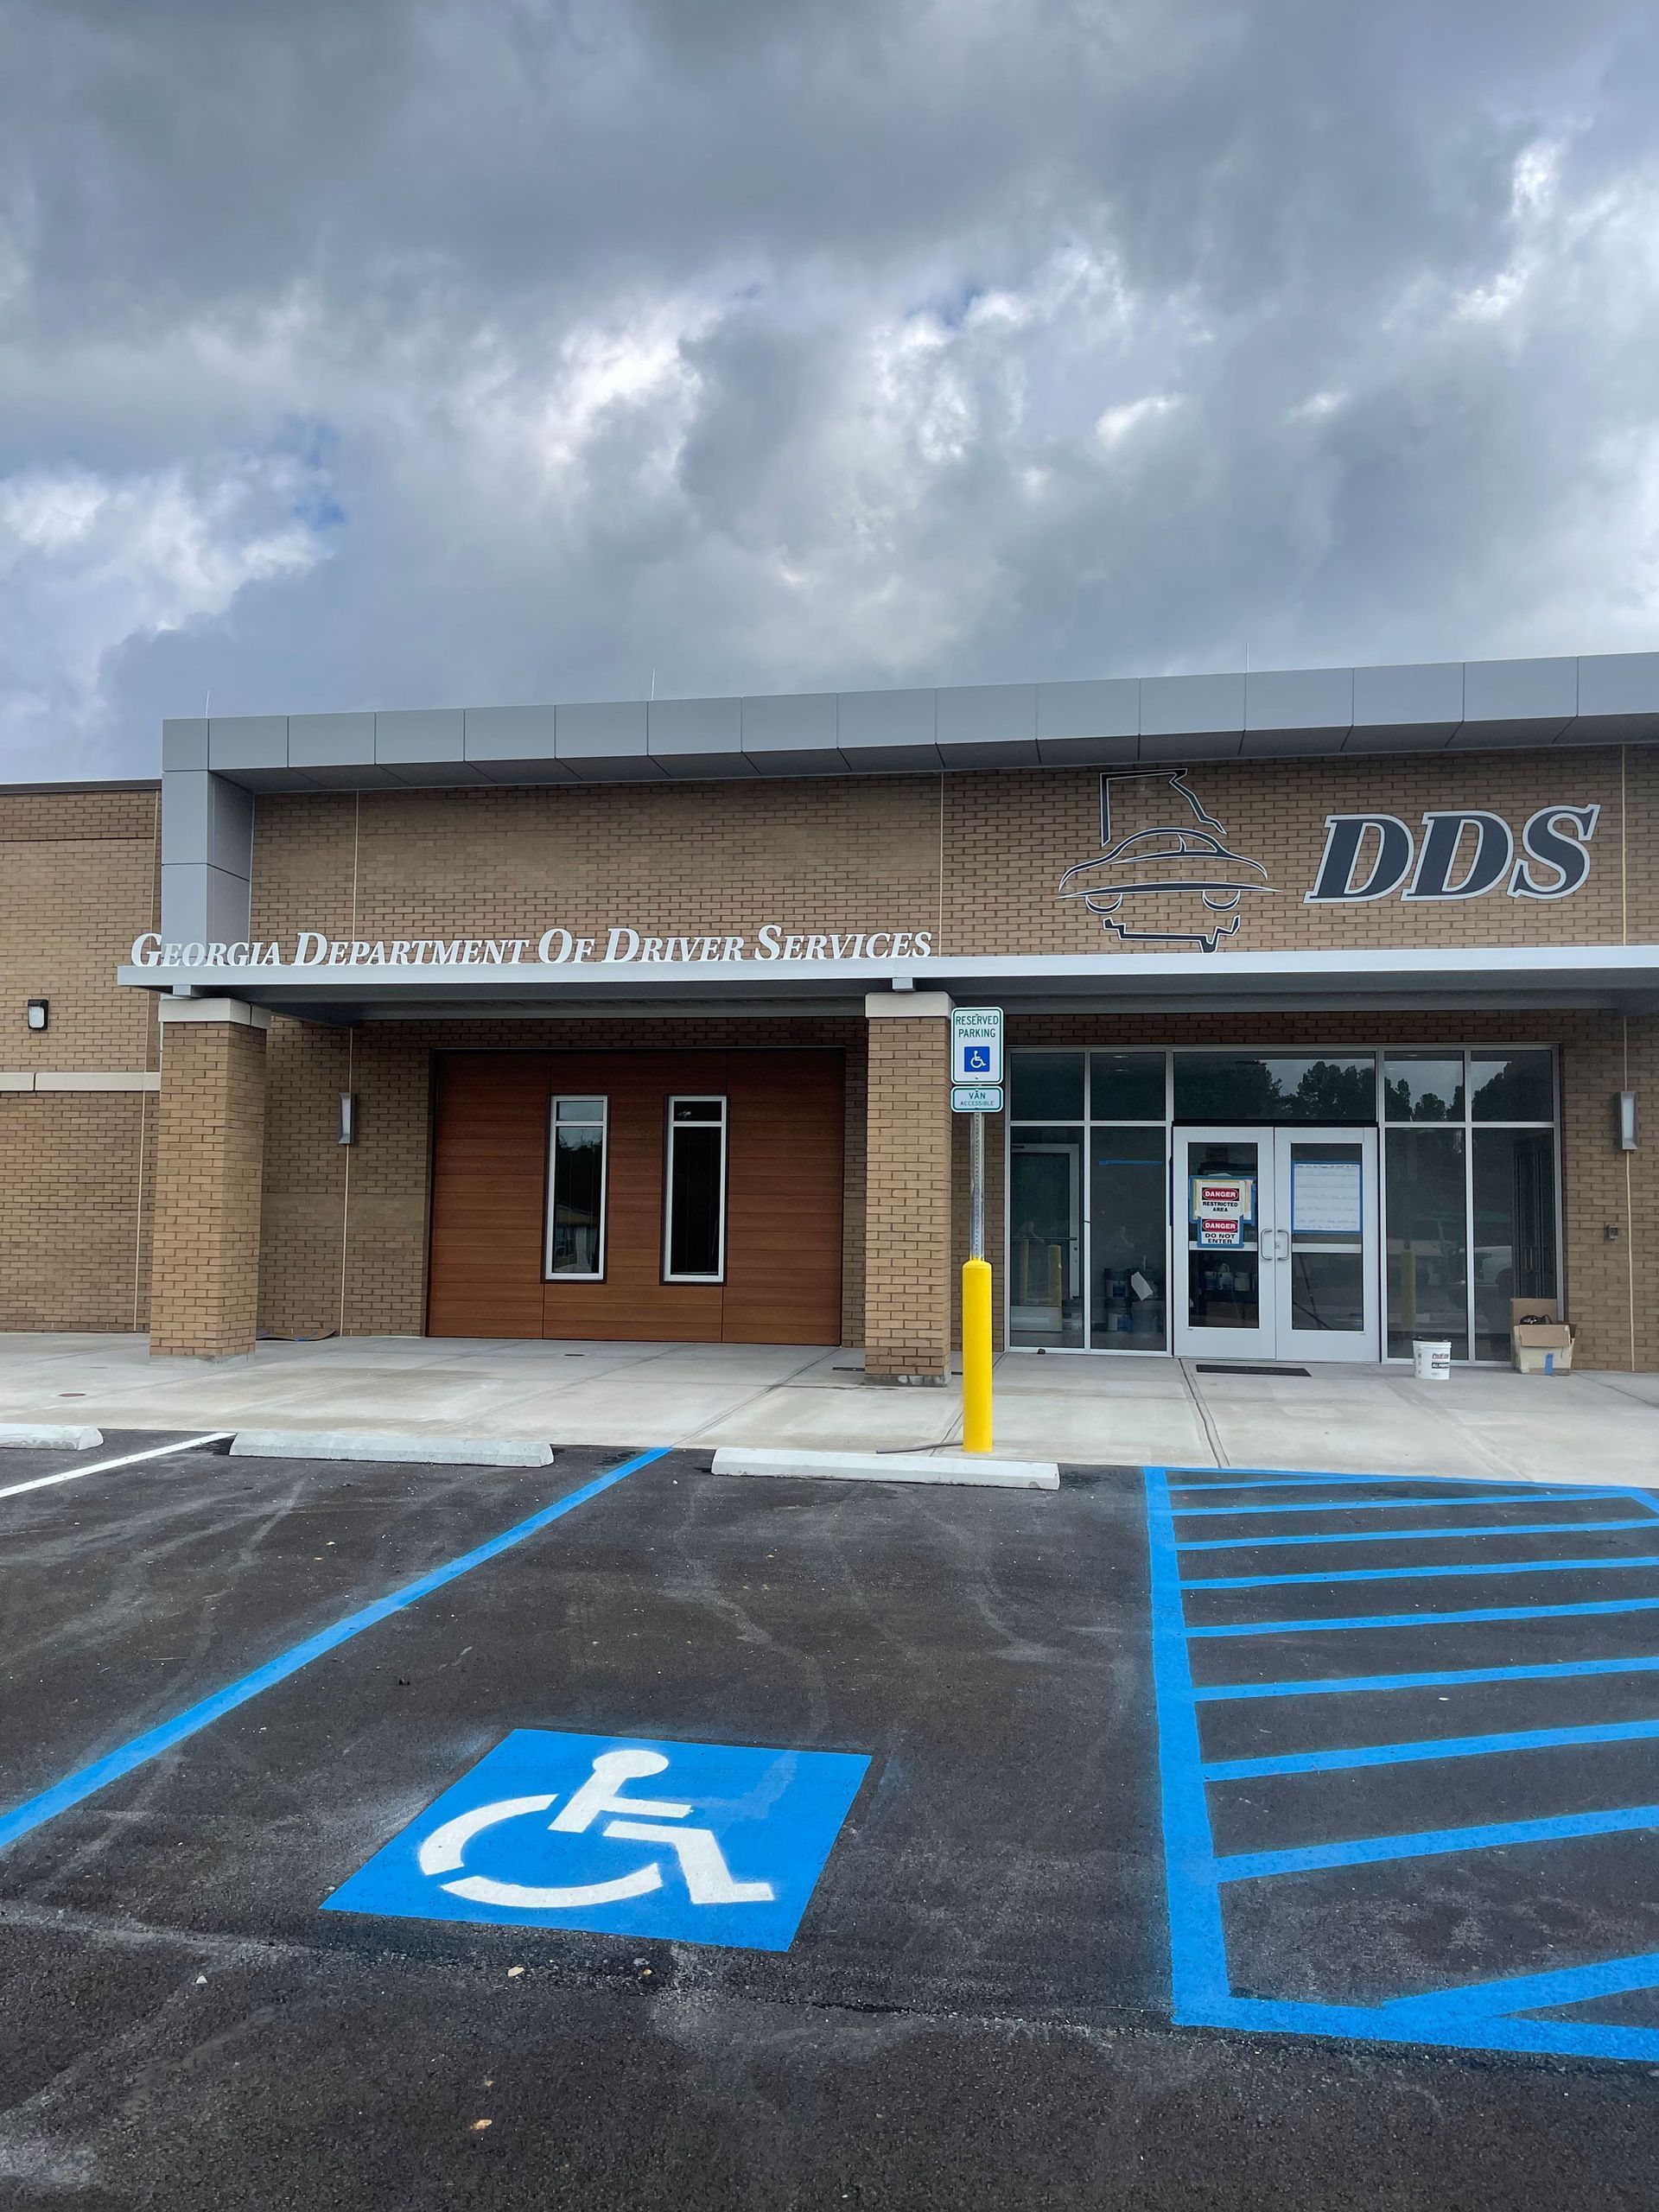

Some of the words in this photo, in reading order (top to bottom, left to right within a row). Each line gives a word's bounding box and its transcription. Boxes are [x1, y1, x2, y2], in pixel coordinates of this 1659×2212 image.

[1303, 804, 1601, 904] DDS
[130, 931, 283, 967] GEORGIA
[290, 931, 530, 966] DEPARTMENT
[601, 927, 745, 963] DRIVER
[753, 924, 932, 961] SERVICES
[956, 1015, 999, 1026] RESERVED
[958, 1028, 995, 1038] PARKING
